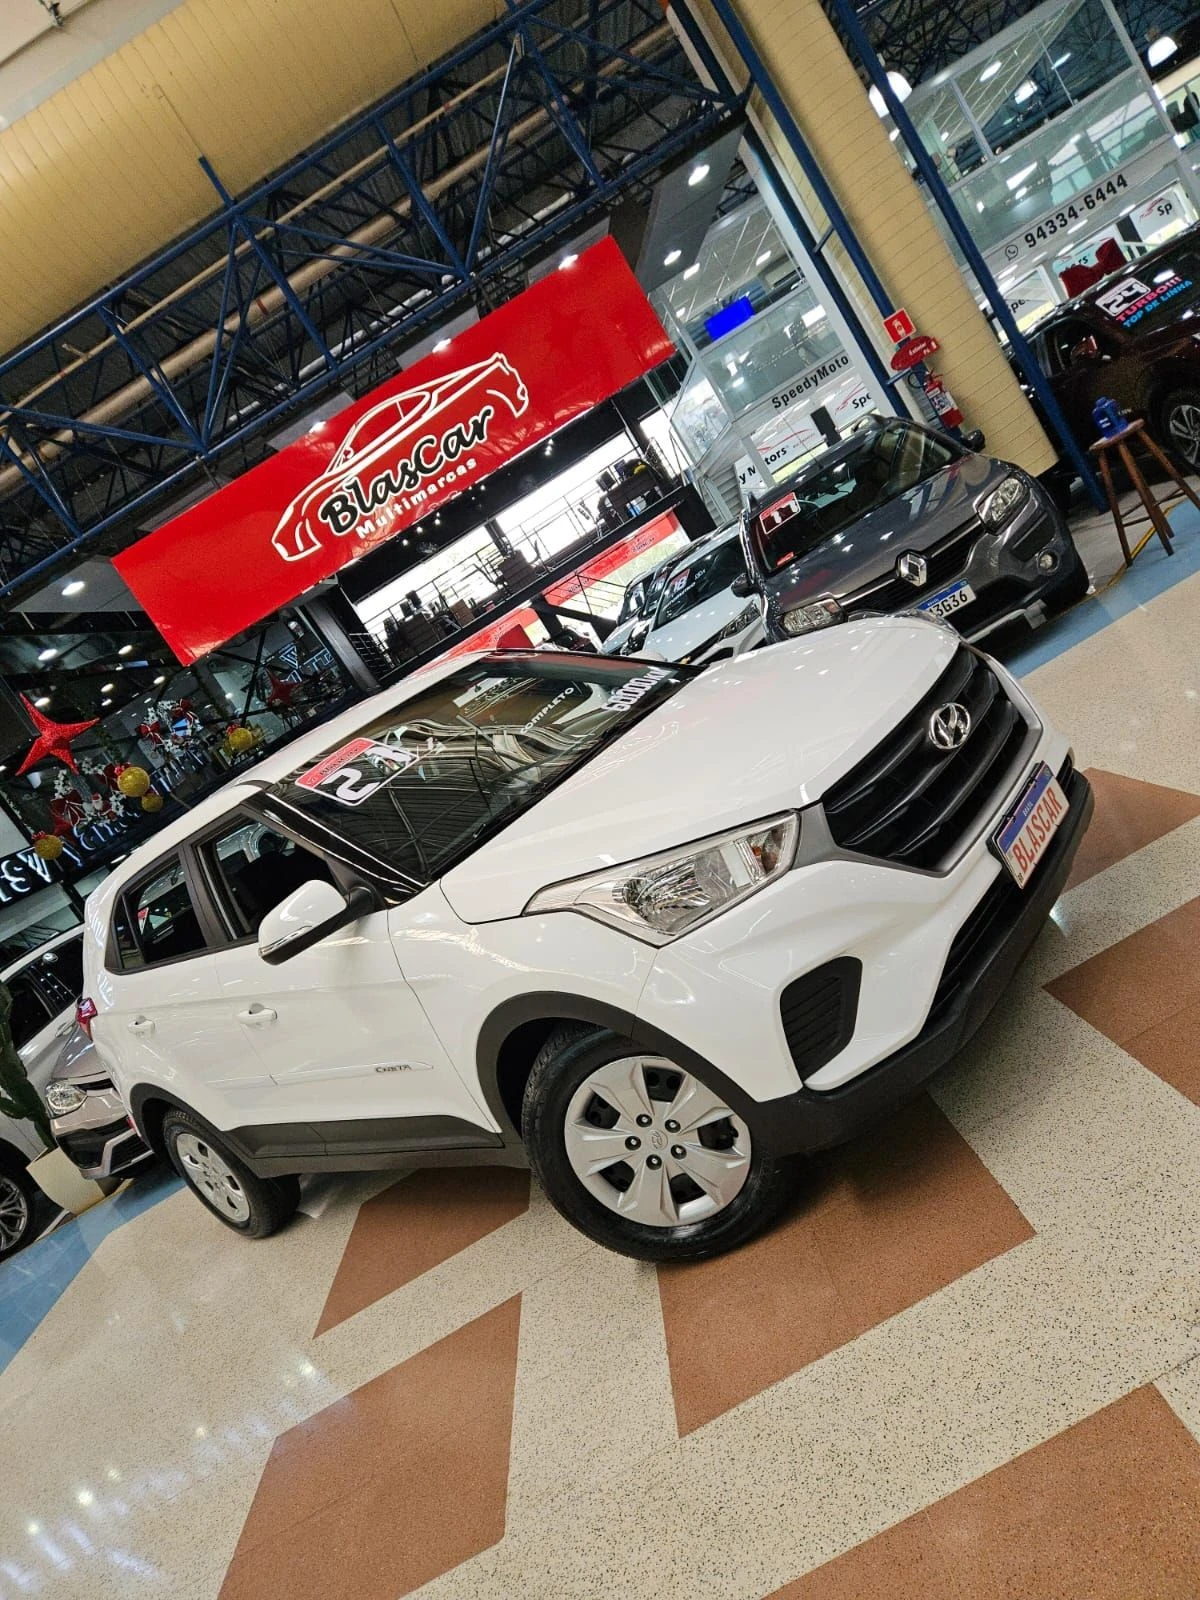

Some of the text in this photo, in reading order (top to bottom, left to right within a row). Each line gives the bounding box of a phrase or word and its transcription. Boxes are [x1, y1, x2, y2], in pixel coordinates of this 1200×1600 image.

[1024, 174, 1128, 248] 94334-6444
[1122, 279, 1193, 328] TOP DE LINHA
[771, 355, 849, 410] SpeedyMoto
[319, 406, 494, 536] BlasCar
[355, 457, 478, 539] Multimarcas
[929, 590, 968, 617] 3G36
[519, 687, 575, 734] COMPLETO
[1012, 786, 1062, 874] BLASCAR
